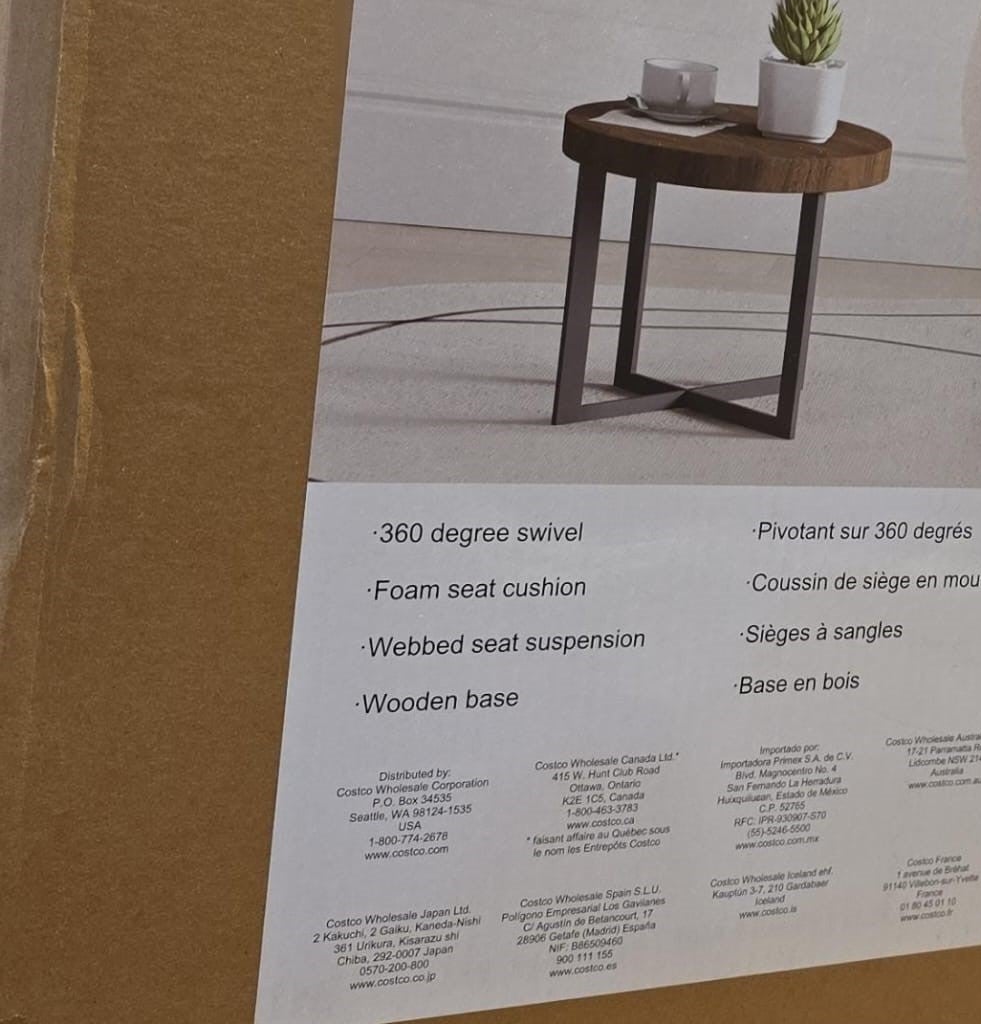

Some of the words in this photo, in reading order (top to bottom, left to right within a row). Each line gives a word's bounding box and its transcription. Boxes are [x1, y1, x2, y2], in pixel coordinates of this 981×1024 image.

[431, 523, 509, 548] degree
[517, 522, 583, 542] swivel
[840, 525, 869, 539] sur
[874, 522, 907, 539] 360
[913, 521, 972, 543] degrés
[448, 579, 495, 598] seat
[503, 577, 586, 597] cushion
[835, 573, 857, 590] de
[863, 572, 910, 593] siège
[916, 574, 937, 589] en
[816, 623, 827, 640] à
[833, 622, 903, 644] sangles
[472, 633, 518, 653] seat
[526, 630, 645, 655] suspension
[794, 677, 816, 691] en
[823, 672, 860, 690] bois
[465, 689, 519, 708] base
[760, 744, 801, 756] Importado
[535, 761, 568, 770] Costco
[571, 756, 618, 768] Wholesale
[621, 754, 656, 765] Canada
[909, 758, 945, 767] Lidcombe
[379, 769, 433, 781] Distributed
[436, 768, 451, 778] by:
[552, 771, 570, 781] 415
[588, 769, 610, 778] Hunt
[613, 767, 633, 777] Club
[636, 765, 660, 775] Road
[336, 788, 372, 798] Costco
[376, 783, 428, 795] Wholesale
[432, 778, 489, 791] Corporation
[570, 783, 604, 793] Ottawa,
[608, 780, 641, 789] Ontario
[727, 783, 744, 793] San
[747, 779, 786, 791] Fernando
[789, 778, 798, 787] La
[801, 776, 842, 787] Herradura
[373, 798, 395, 808] P.O.
[399, 797, 418, 806] Box
[421, 793, 452, 804] 34535
[562, 796, 582, 805] K2E
[609, 792, 644, 801] Canada
[349, 812, 388, 822] Seattle,
[392, 810, 409, 819] WA
[413, 804, 472, 817] 98124-1535
[567, 804, 638, 817] 1-800-463-3783
[399, 821, 421, 831] USA
[567, 817, 635, 830] www.costco.ca
[369, 832, 448, 847] 1-800-774-2678
[533, 835, 564, 845] faisant
[567, 832, 595, 843] affaire
[598, 831, 609, 839] au
[612, 827, 647, 838] Québec
[649, 826, 670, 835] sous
[365, 845, 448, 860] www.costco.com
[533, 848, 541, 857] le
[545, 847, 564, 856] nom
[568, 845, 581, 854] les
[630, 838, 660, 848] Costco
[520, 898, 552, 908] Costco
[555, 892, 603, 904] Wholesale
[606, 889, 631, 900] Spain
[755, 895, 785, 906] Iceland
[326, 918, 362, 929] Costco
[365, 912, 417, 925] Wholesale
[421, 908, 450, 920] Japan
[454, 905, 471, 916] Ltd.
[313, 933, 320, 943] 2
[323, 930, 366, 942] Kakuchi,
[370, 927, 377, 937] 2
[415, 916, 481, 932] Kaneda-Nishi
[334, 943, 352, 954] 361
[399, 935, 441, 947] Kisarazu
[445, 931, 459, 941] shi
[337, 954, 369, 966] Chiba,
[373, 948, 420, 962] 292-0007
[423, 945, 453, 957] Japan
[556, 955, 573, 964] 900
[577, 951, 593, 962] 111
[597, 949, 613, 959] 155
[360, 959, 429, 976] 0570-200-800
[550, 963, 617, 977] www.costco.es
